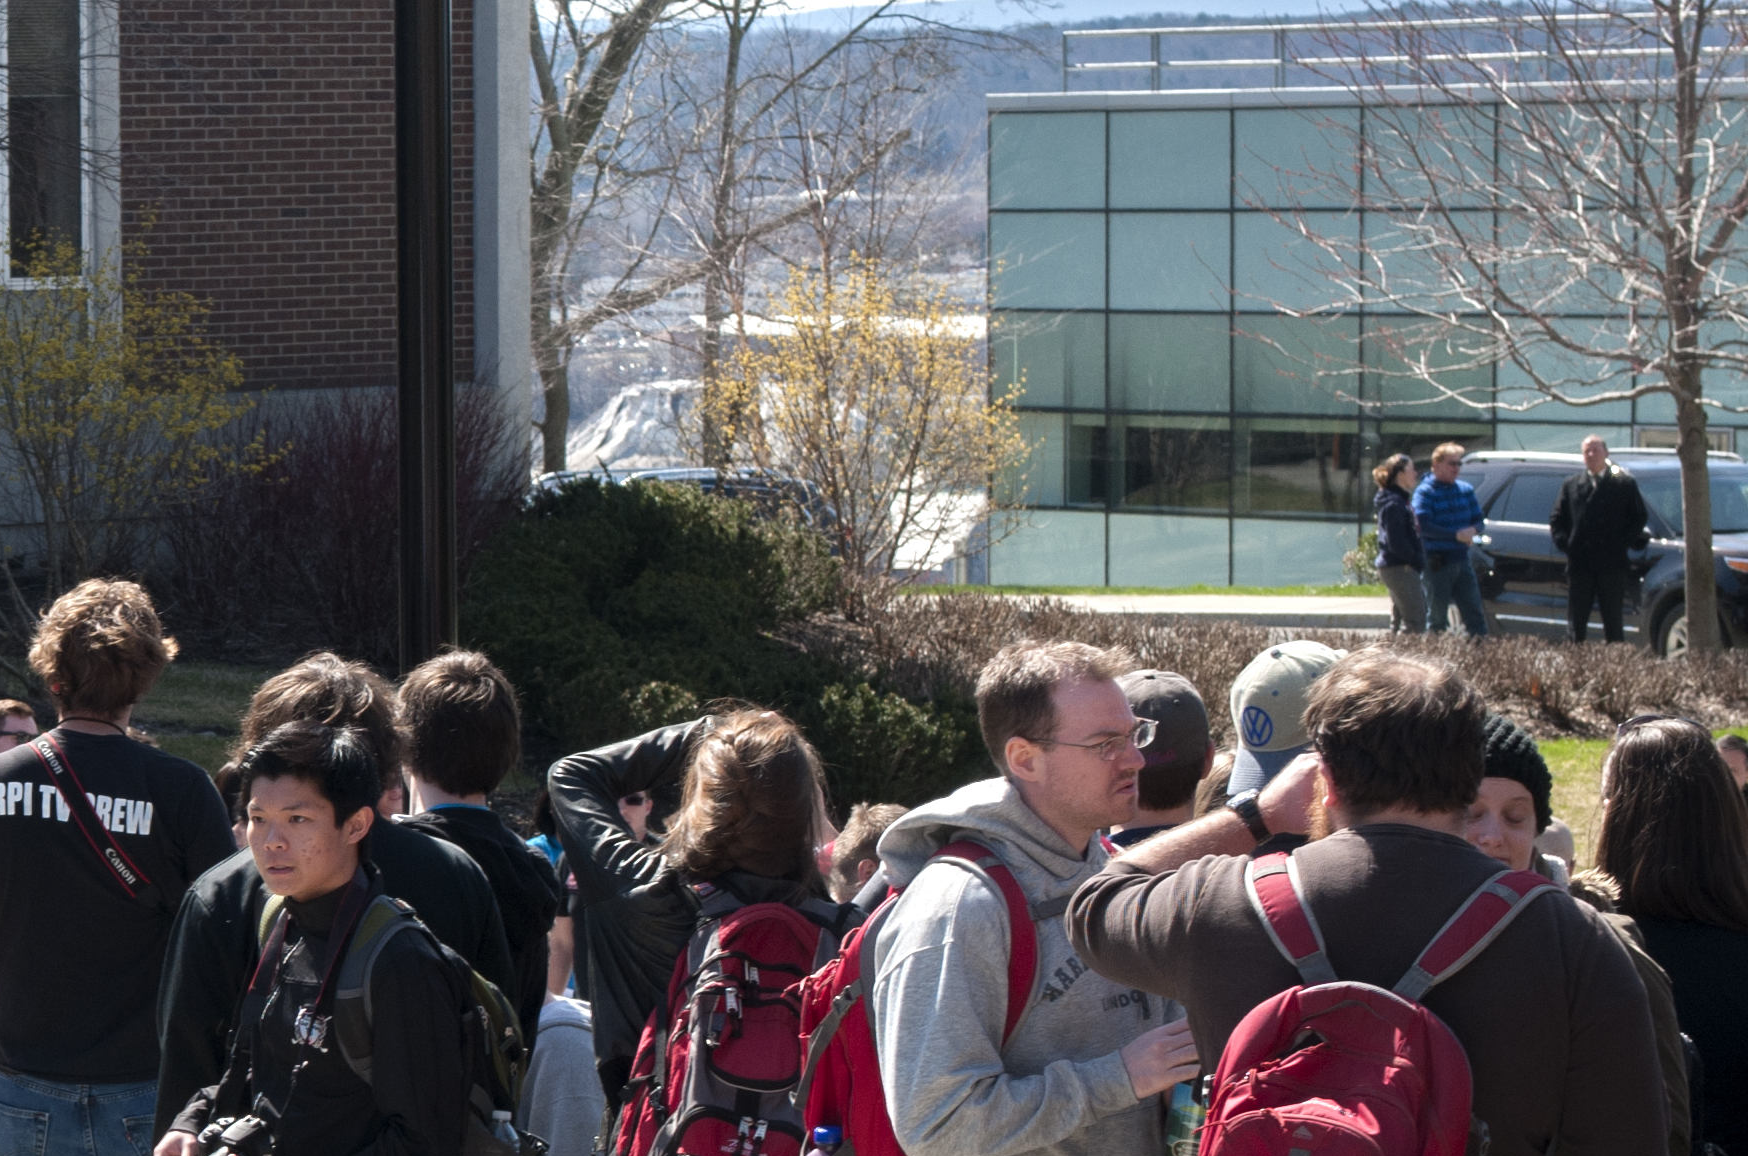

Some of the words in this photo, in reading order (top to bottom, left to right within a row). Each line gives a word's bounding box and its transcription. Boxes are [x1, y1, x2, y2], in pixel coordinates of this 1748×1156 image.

[37, 740, 63, 775] Canon
[39, 784, 72, 823] TV
[105, 848, 137, 884] Canon
